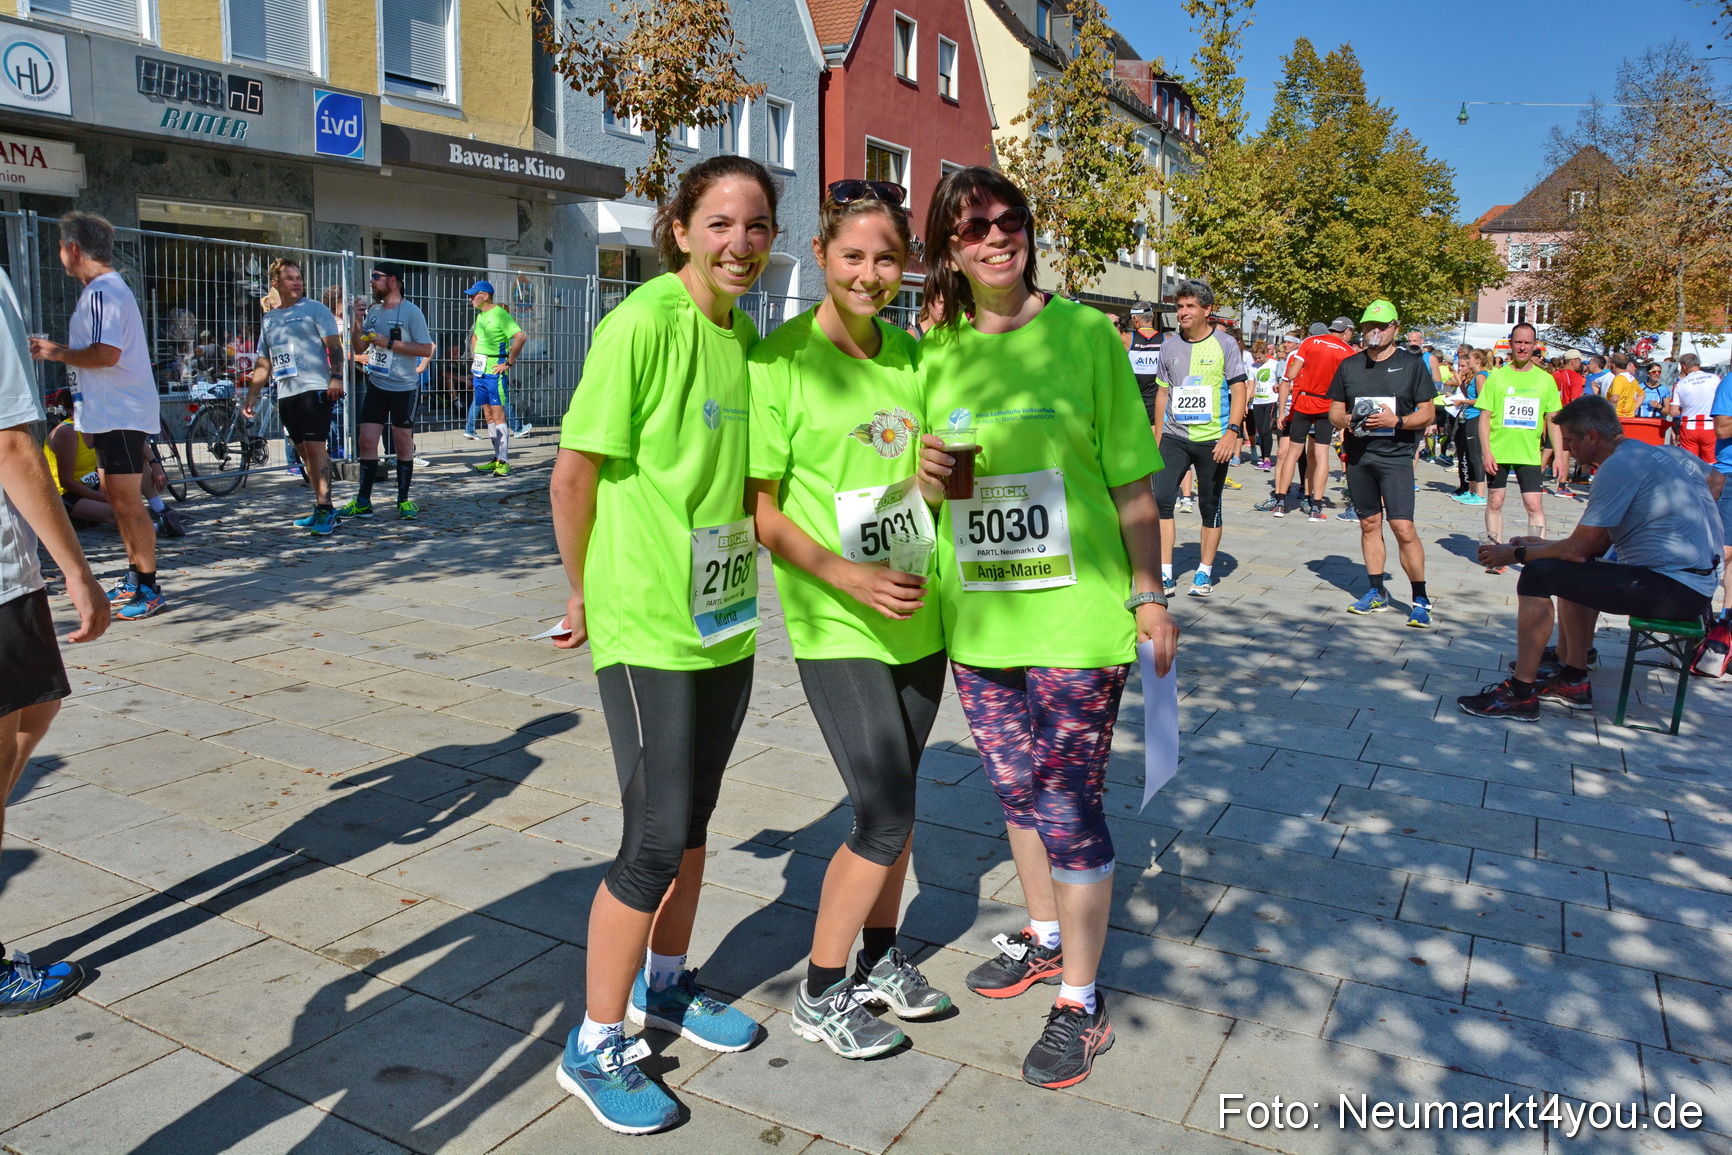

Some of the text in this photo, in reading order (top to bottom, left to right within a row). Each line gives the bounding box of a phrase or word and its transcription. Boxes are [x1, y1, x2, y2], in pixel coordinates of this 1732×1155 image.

[160, 107, 249, 140] RITTER
[320, 110, 358, 138] ivd
[449, 143, 566, 181] Bavaria-Kino
[1135, 357, 1158, 365] AIM
[990, 408, 1021, 416] katholische
[1177, 396, 1207, 409] 2228
[1508, 405, 1535, 417] 2169
[873, 489, 903, 510] BOCK
[980, 485, 1029, 499] BOCK
[860, 508, 920, 556] 5031
[968, 504, 1050, 545] 5030
[718, 531, 749, 549] BOCK
[977, 546, 1036, 557] PARTL Neumarkt
[702, 551, 753, 595] 2168
[977, 561, 1052, 581] Anja-Marie
[713, 609, 738, 628] Maria
